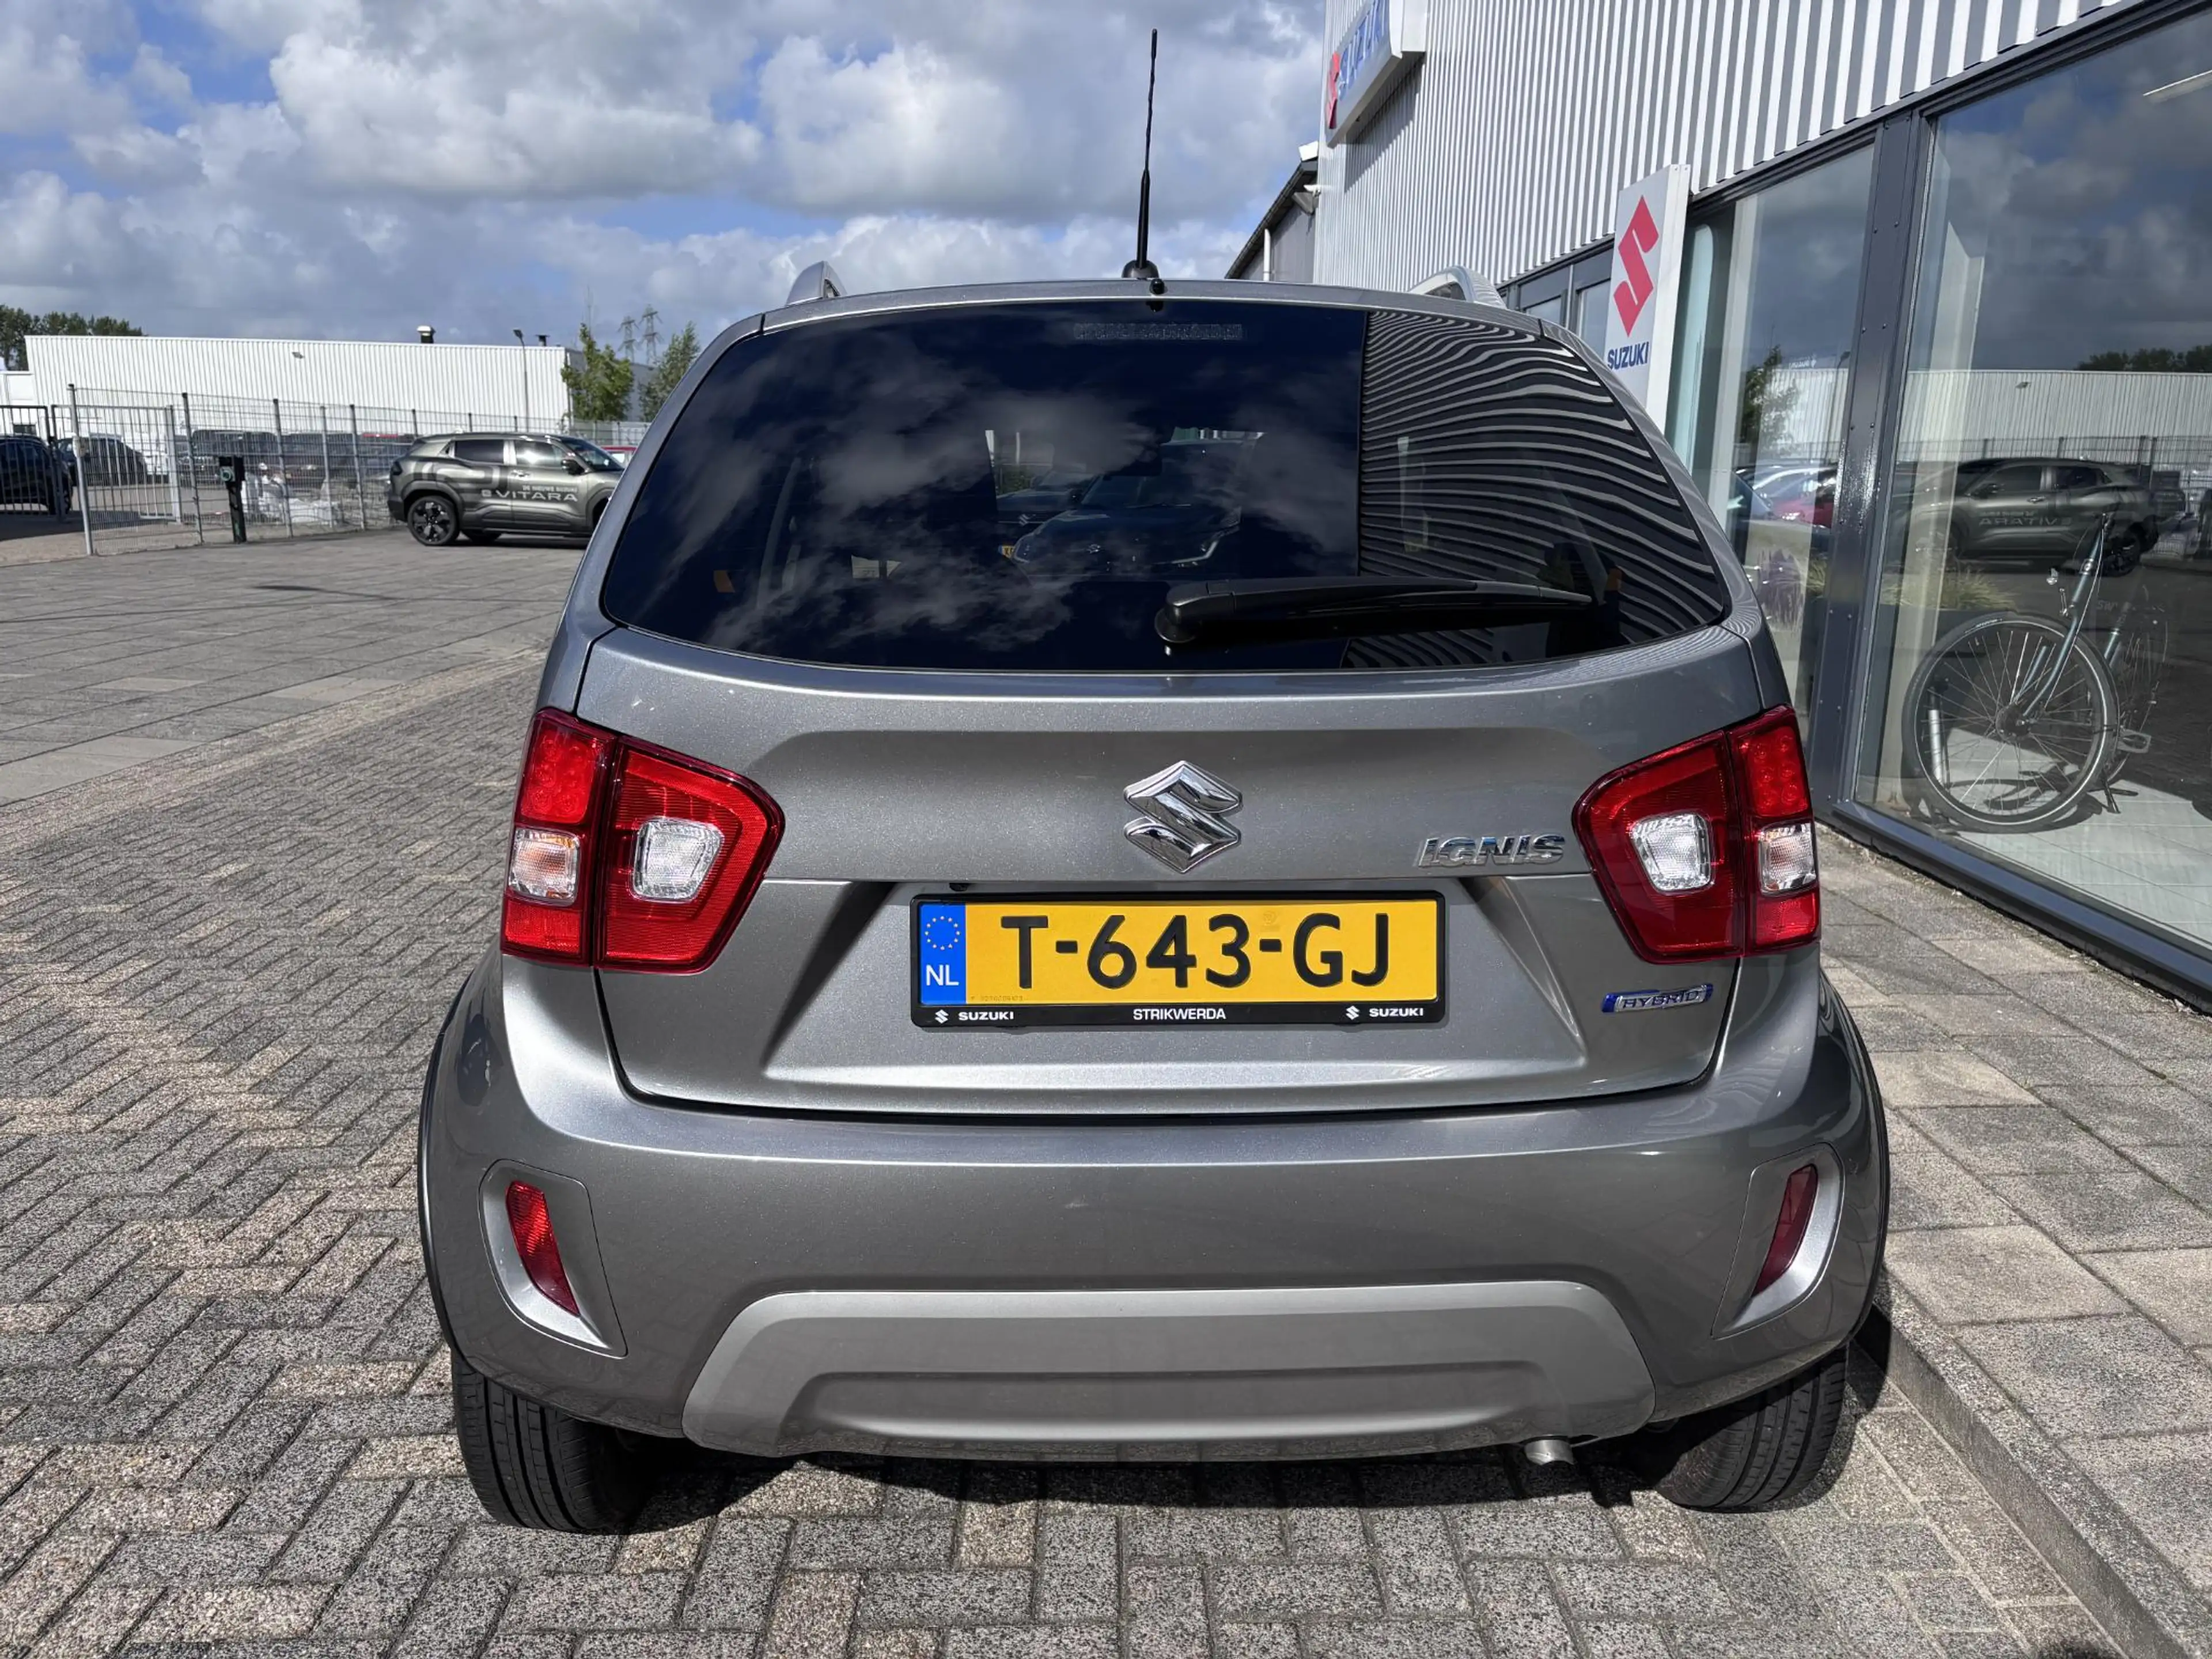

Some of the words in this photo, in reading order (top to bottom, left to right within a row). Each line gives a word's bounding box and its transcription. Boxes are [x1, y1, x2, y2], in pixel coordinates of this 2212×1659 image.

[1607, 341, 1649, 370] SUZUKI
[1418, 835, 1566, 868] IGNIS
[1001, 912, 1390, 989] T-643-GJ
[925, 964, 959, 987] NL
[1622, 990, 1699, 1009] HYBRID
[958, 1011, 1014, 1021] SUZUKI
[1133, 1008, 1226, 1020] STRIKWERDA
[1369, 1007, 1424, 1017] SUZUKI
